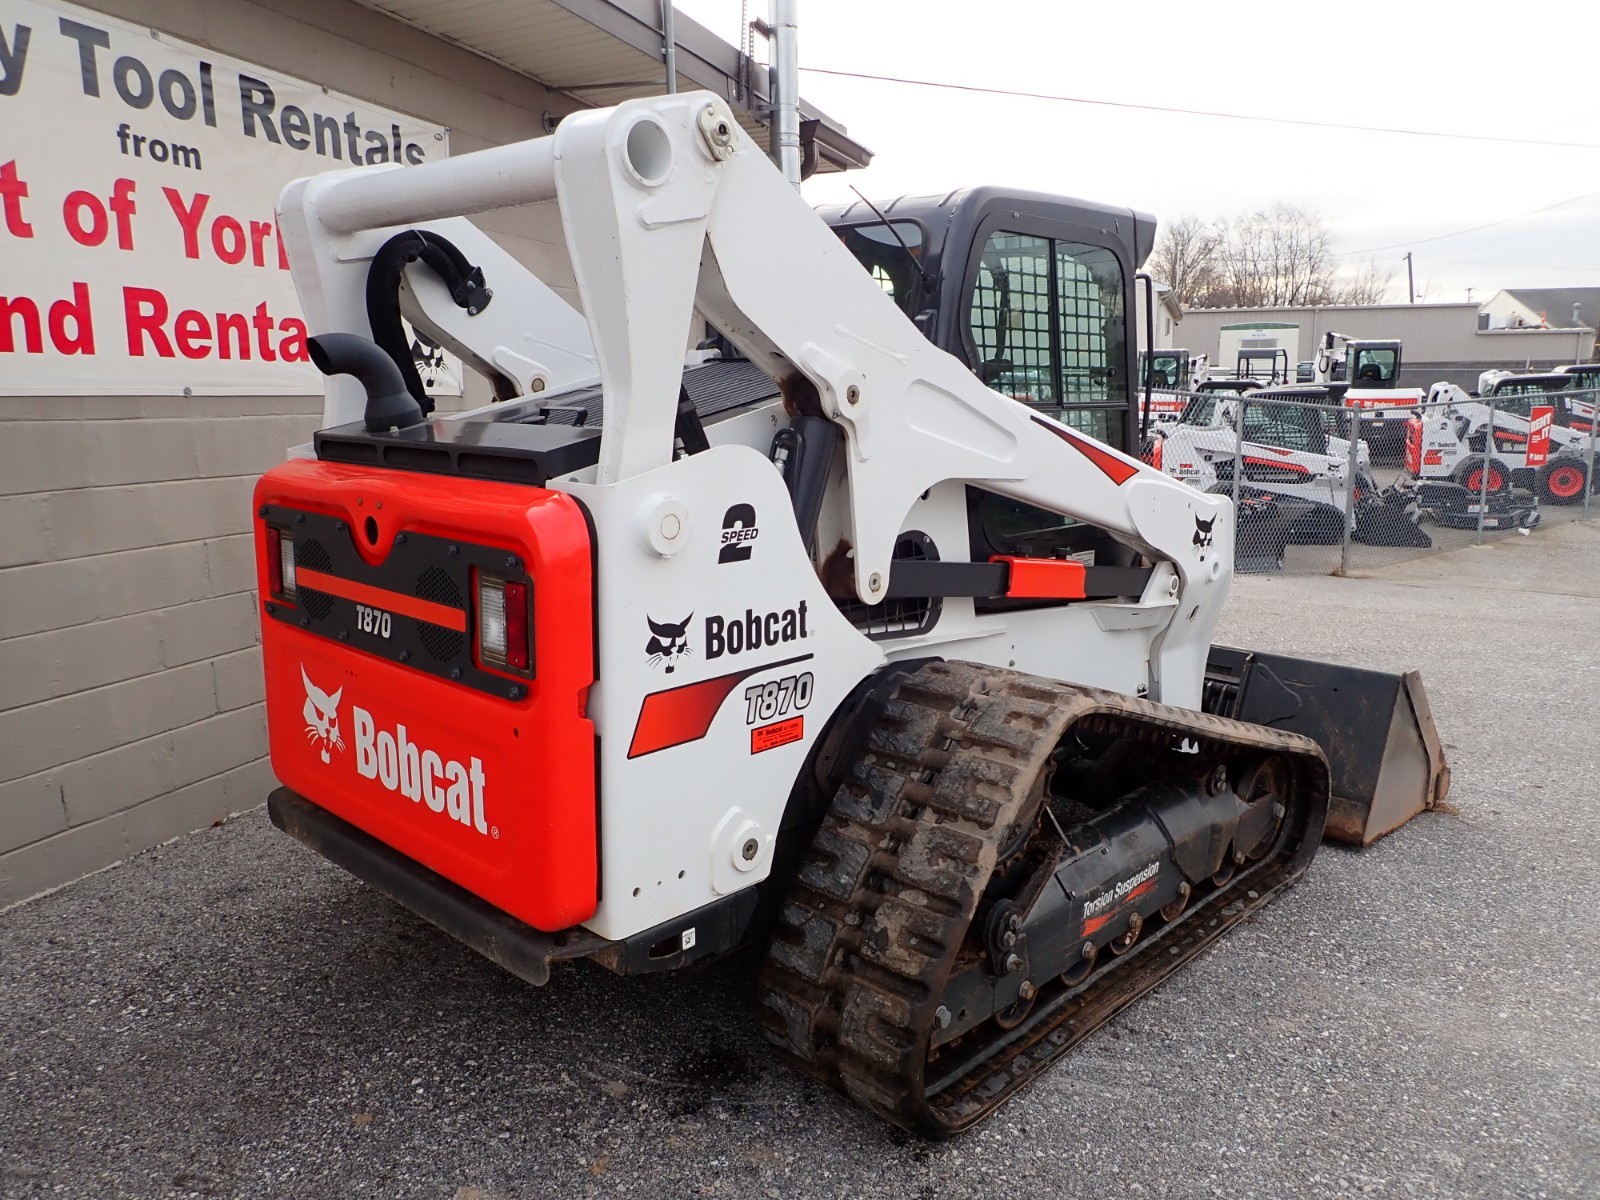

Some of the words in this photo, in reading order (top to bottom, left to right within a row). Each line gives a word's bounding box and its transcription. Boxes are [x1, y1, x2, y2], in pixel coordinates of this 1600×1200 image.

[58, 16, 217, 129] Tool
[238, 73, 426, 167] Rentals
[116, 123, 202, 170] from
[63, 178, 136, 252] of
[718, 503, 757, 564] 2
[720, 528, 759, 544] SPEED
[356, 604, 392, 639] T870
[705, 600, 807, 660] Bobcat
[745, 671, 814, 725] T870
[353, 705, 488, 835] Bobcat
[1083, 889, 1114, 918] Torsion
[1114, 861, 1160, 898] Suspension
